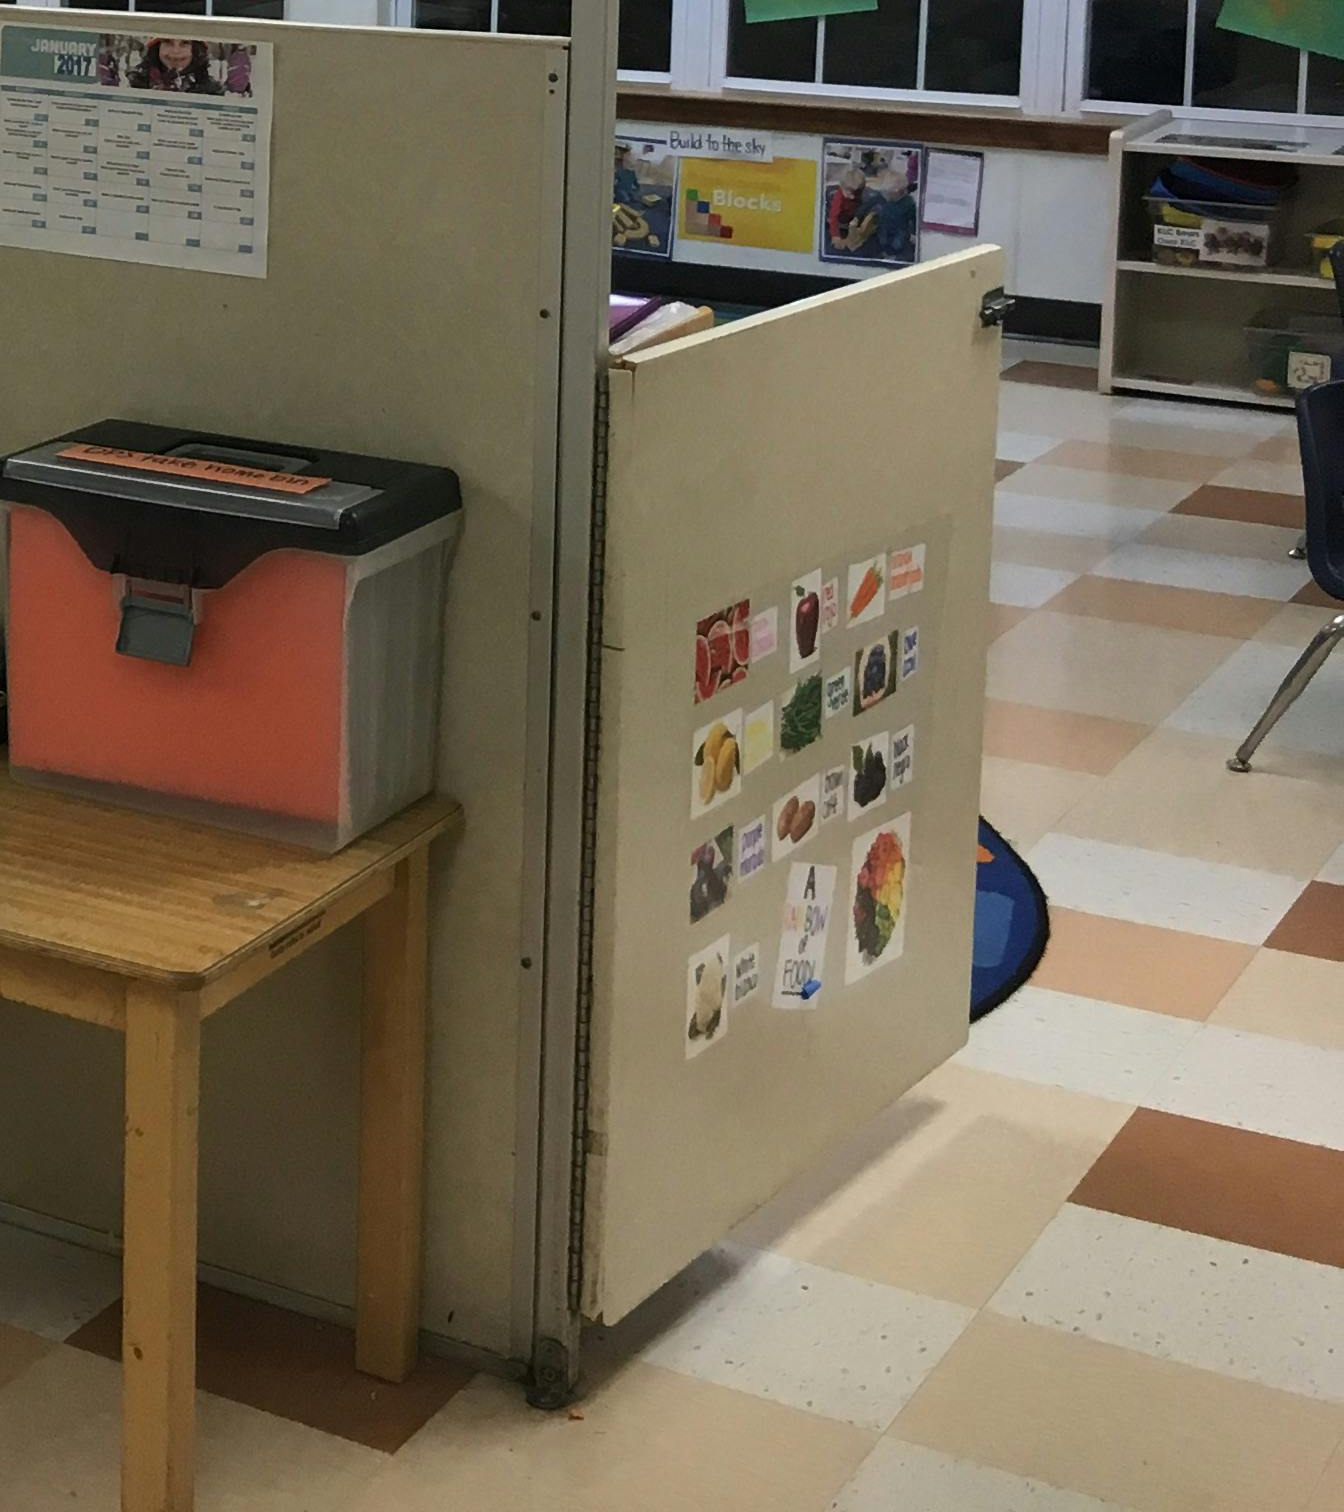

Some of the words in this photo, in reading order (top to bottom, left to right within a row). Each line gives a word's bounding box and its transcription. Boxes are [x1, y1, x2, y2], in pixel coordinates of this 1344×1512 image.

[30, 39, 97, 57] JANUARY
[56, 54, 92, 76] 2017
[670, 131, 703, 150] Build
[706, 134, 719, 152] to
[722, 134, 742, 153] the
[745, 137, 766, 156] sky
[713, 189, 782, 212] Blocks
[803, 865, 816, 900] A
